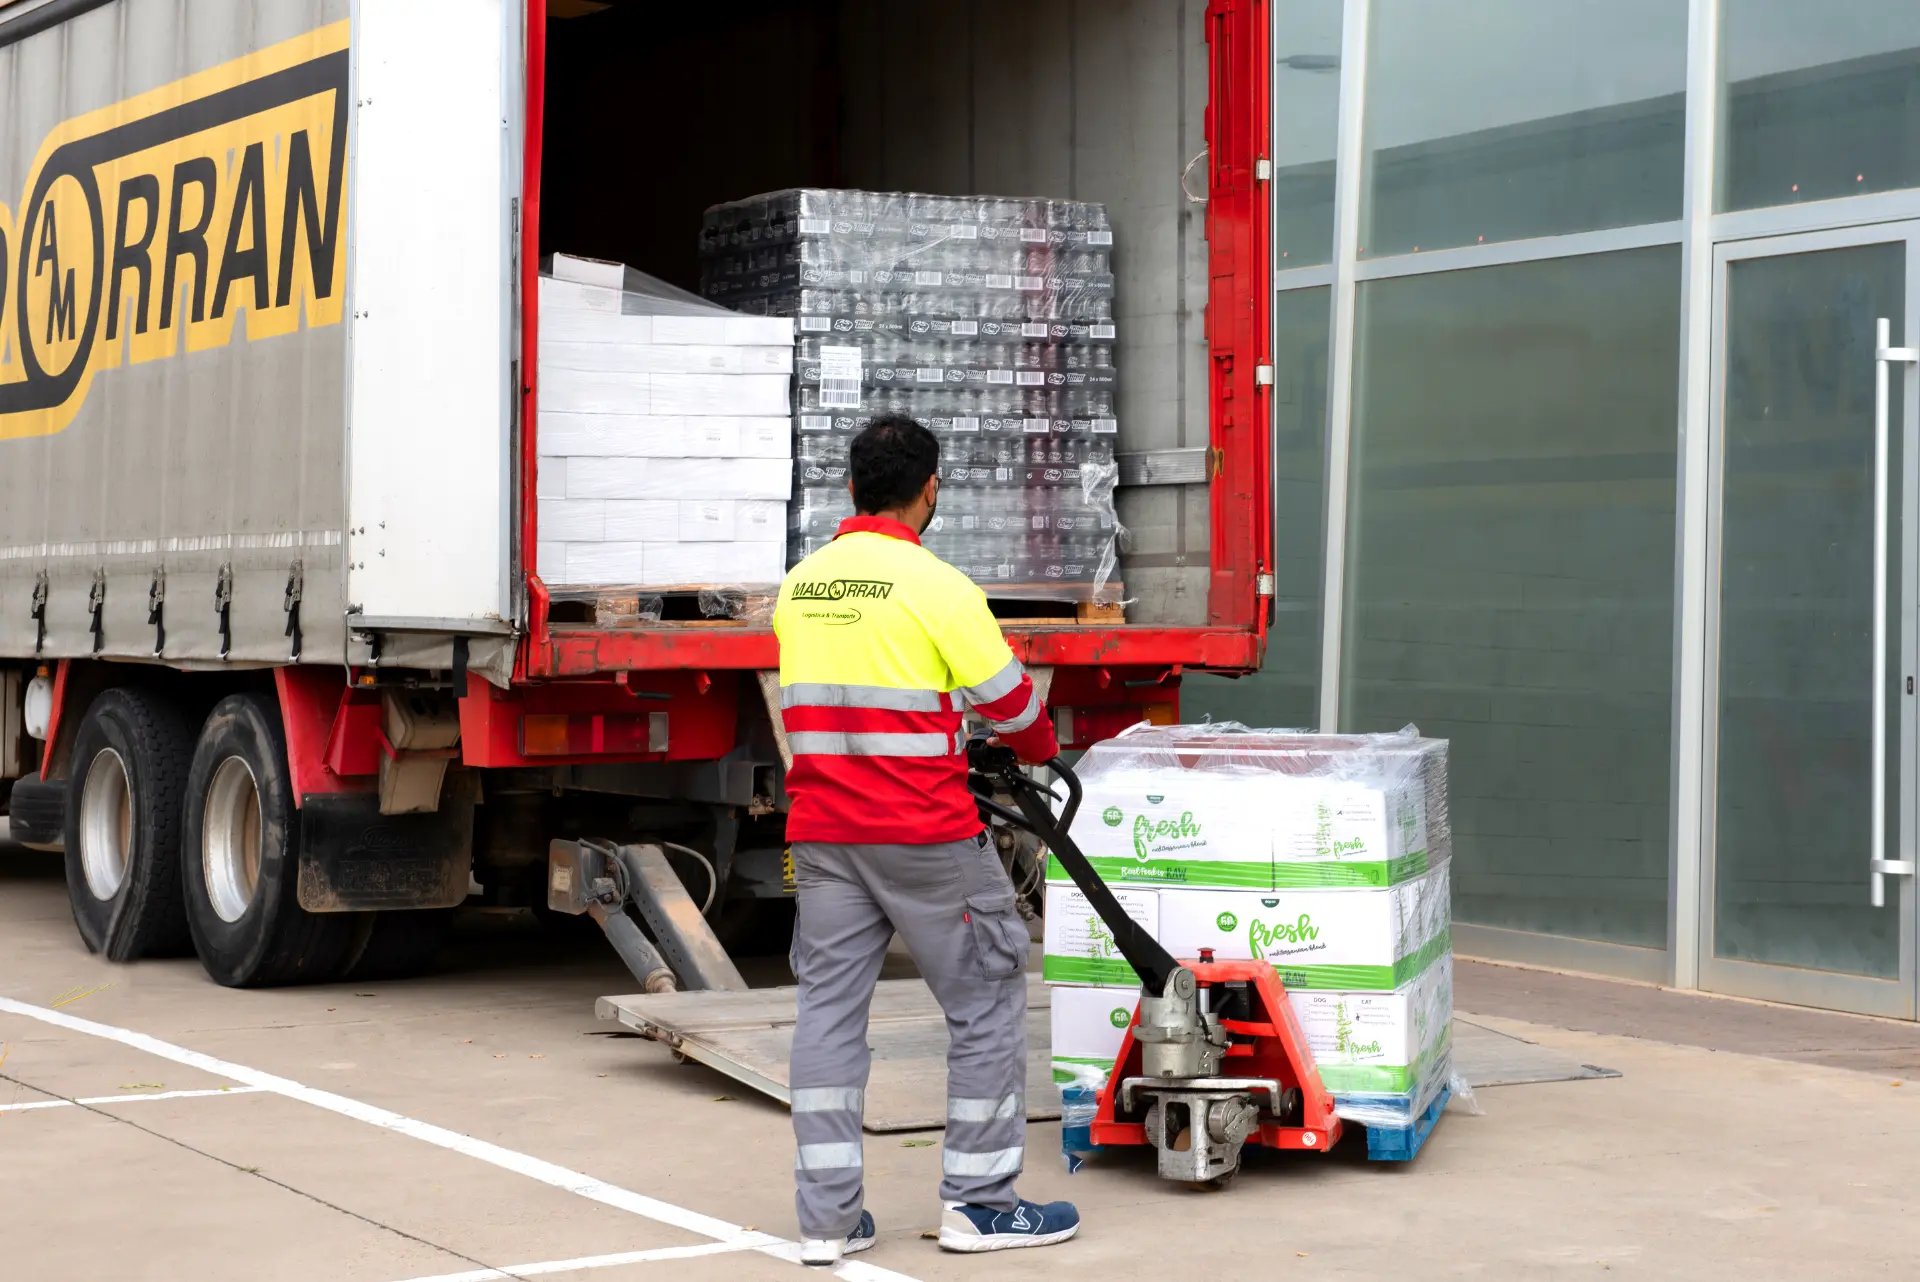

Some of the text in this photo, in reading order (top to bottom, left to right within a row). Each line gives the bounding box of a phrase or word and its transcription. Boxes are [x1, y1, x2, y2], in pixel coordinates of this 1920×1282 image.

[791, 580, 894, 600] MADORRAN
[1133, 811, 1202, 859] fresh
[1333, 836, 1365, 860] fresh
[1166, 867, 1188, 880] RAW
[1248, 913, 1320, 960] fresh
[1284, 971, 1307, 983] RAW
[1350, 1040, 1382, 1063] fresh
